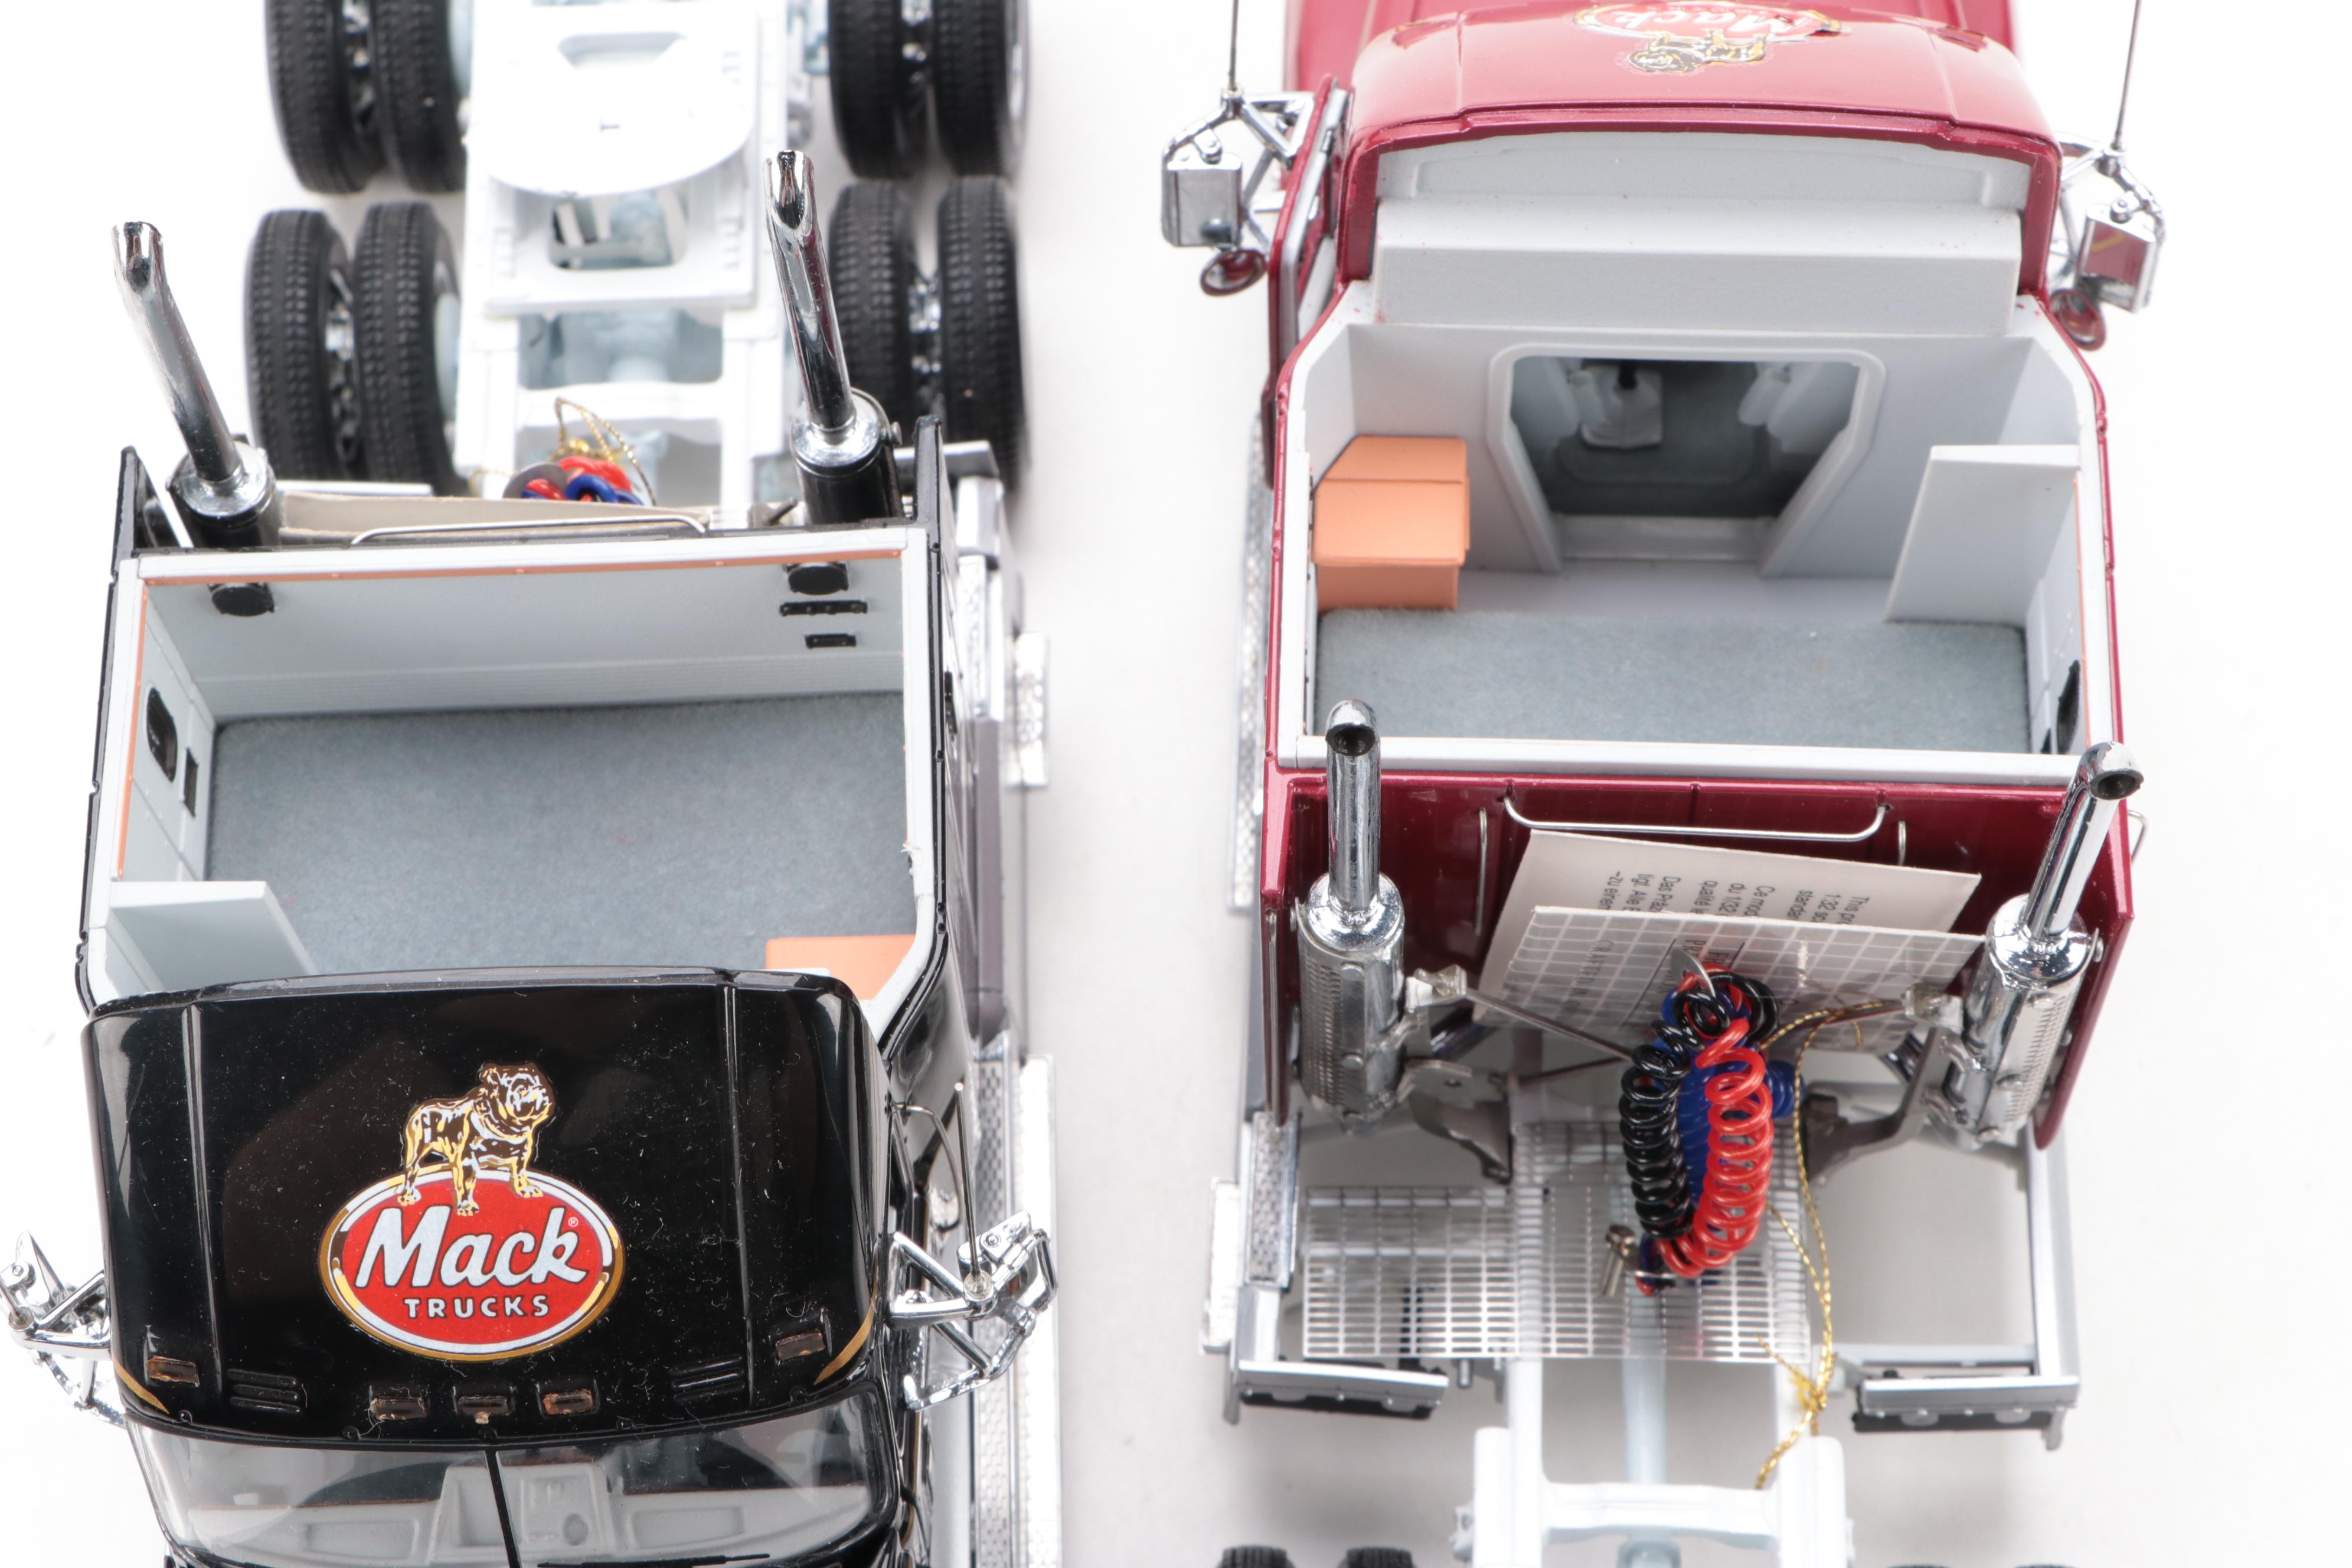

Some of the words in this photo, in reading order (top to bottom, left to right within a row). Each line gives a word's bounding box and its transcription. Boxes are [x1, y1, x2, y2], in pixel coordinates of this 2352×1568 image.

[1612, 10, 1811, 34] Mack
[1658, 876, 1681, 891] Das
[1728, 883, 1748, 894] du
[1753, 885, 1776, 897] Ce
[1626, 889, 1647, 905] Alle
[1694, 880, 1719, 907] qualité
[1719, 896, 1742, 913] 1/32
[1844, 896, 1870, 912] This
[1576, 940, 1614, 984] CRAFTED
[355, 1205, 588, 1287] Mack
[404, 1294, 550, 1319] TRUCKS
